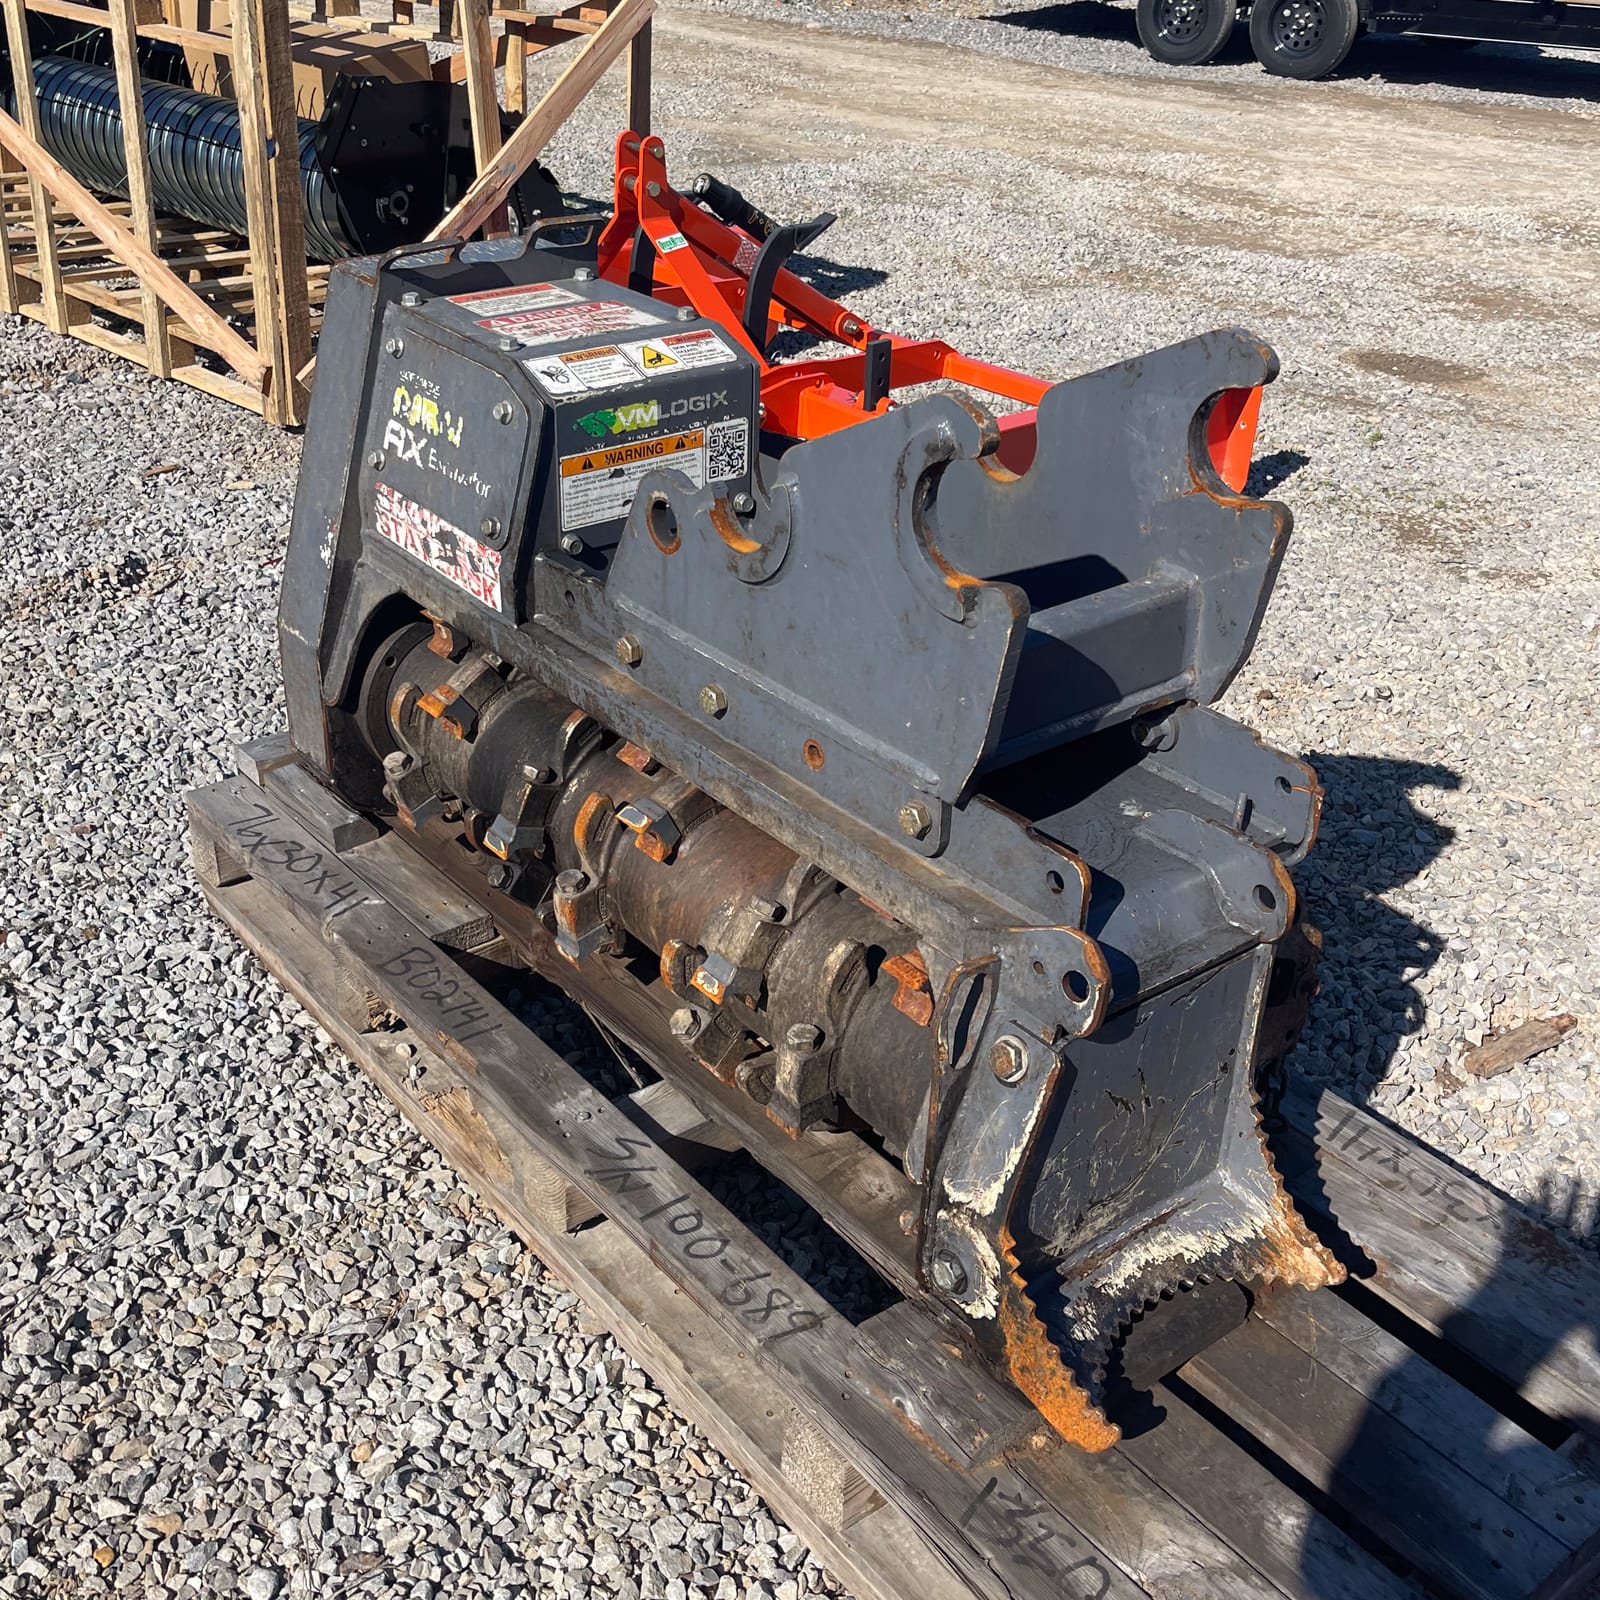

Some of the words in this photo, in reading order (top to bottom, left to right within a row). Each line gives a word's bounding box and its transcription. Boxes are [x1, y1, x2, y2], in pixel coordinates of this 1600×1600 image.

[509, 305, 596, 323] DANGER
[604, 442, 664, 466] WARNING
[376, 946, 504, 1042] B02741
